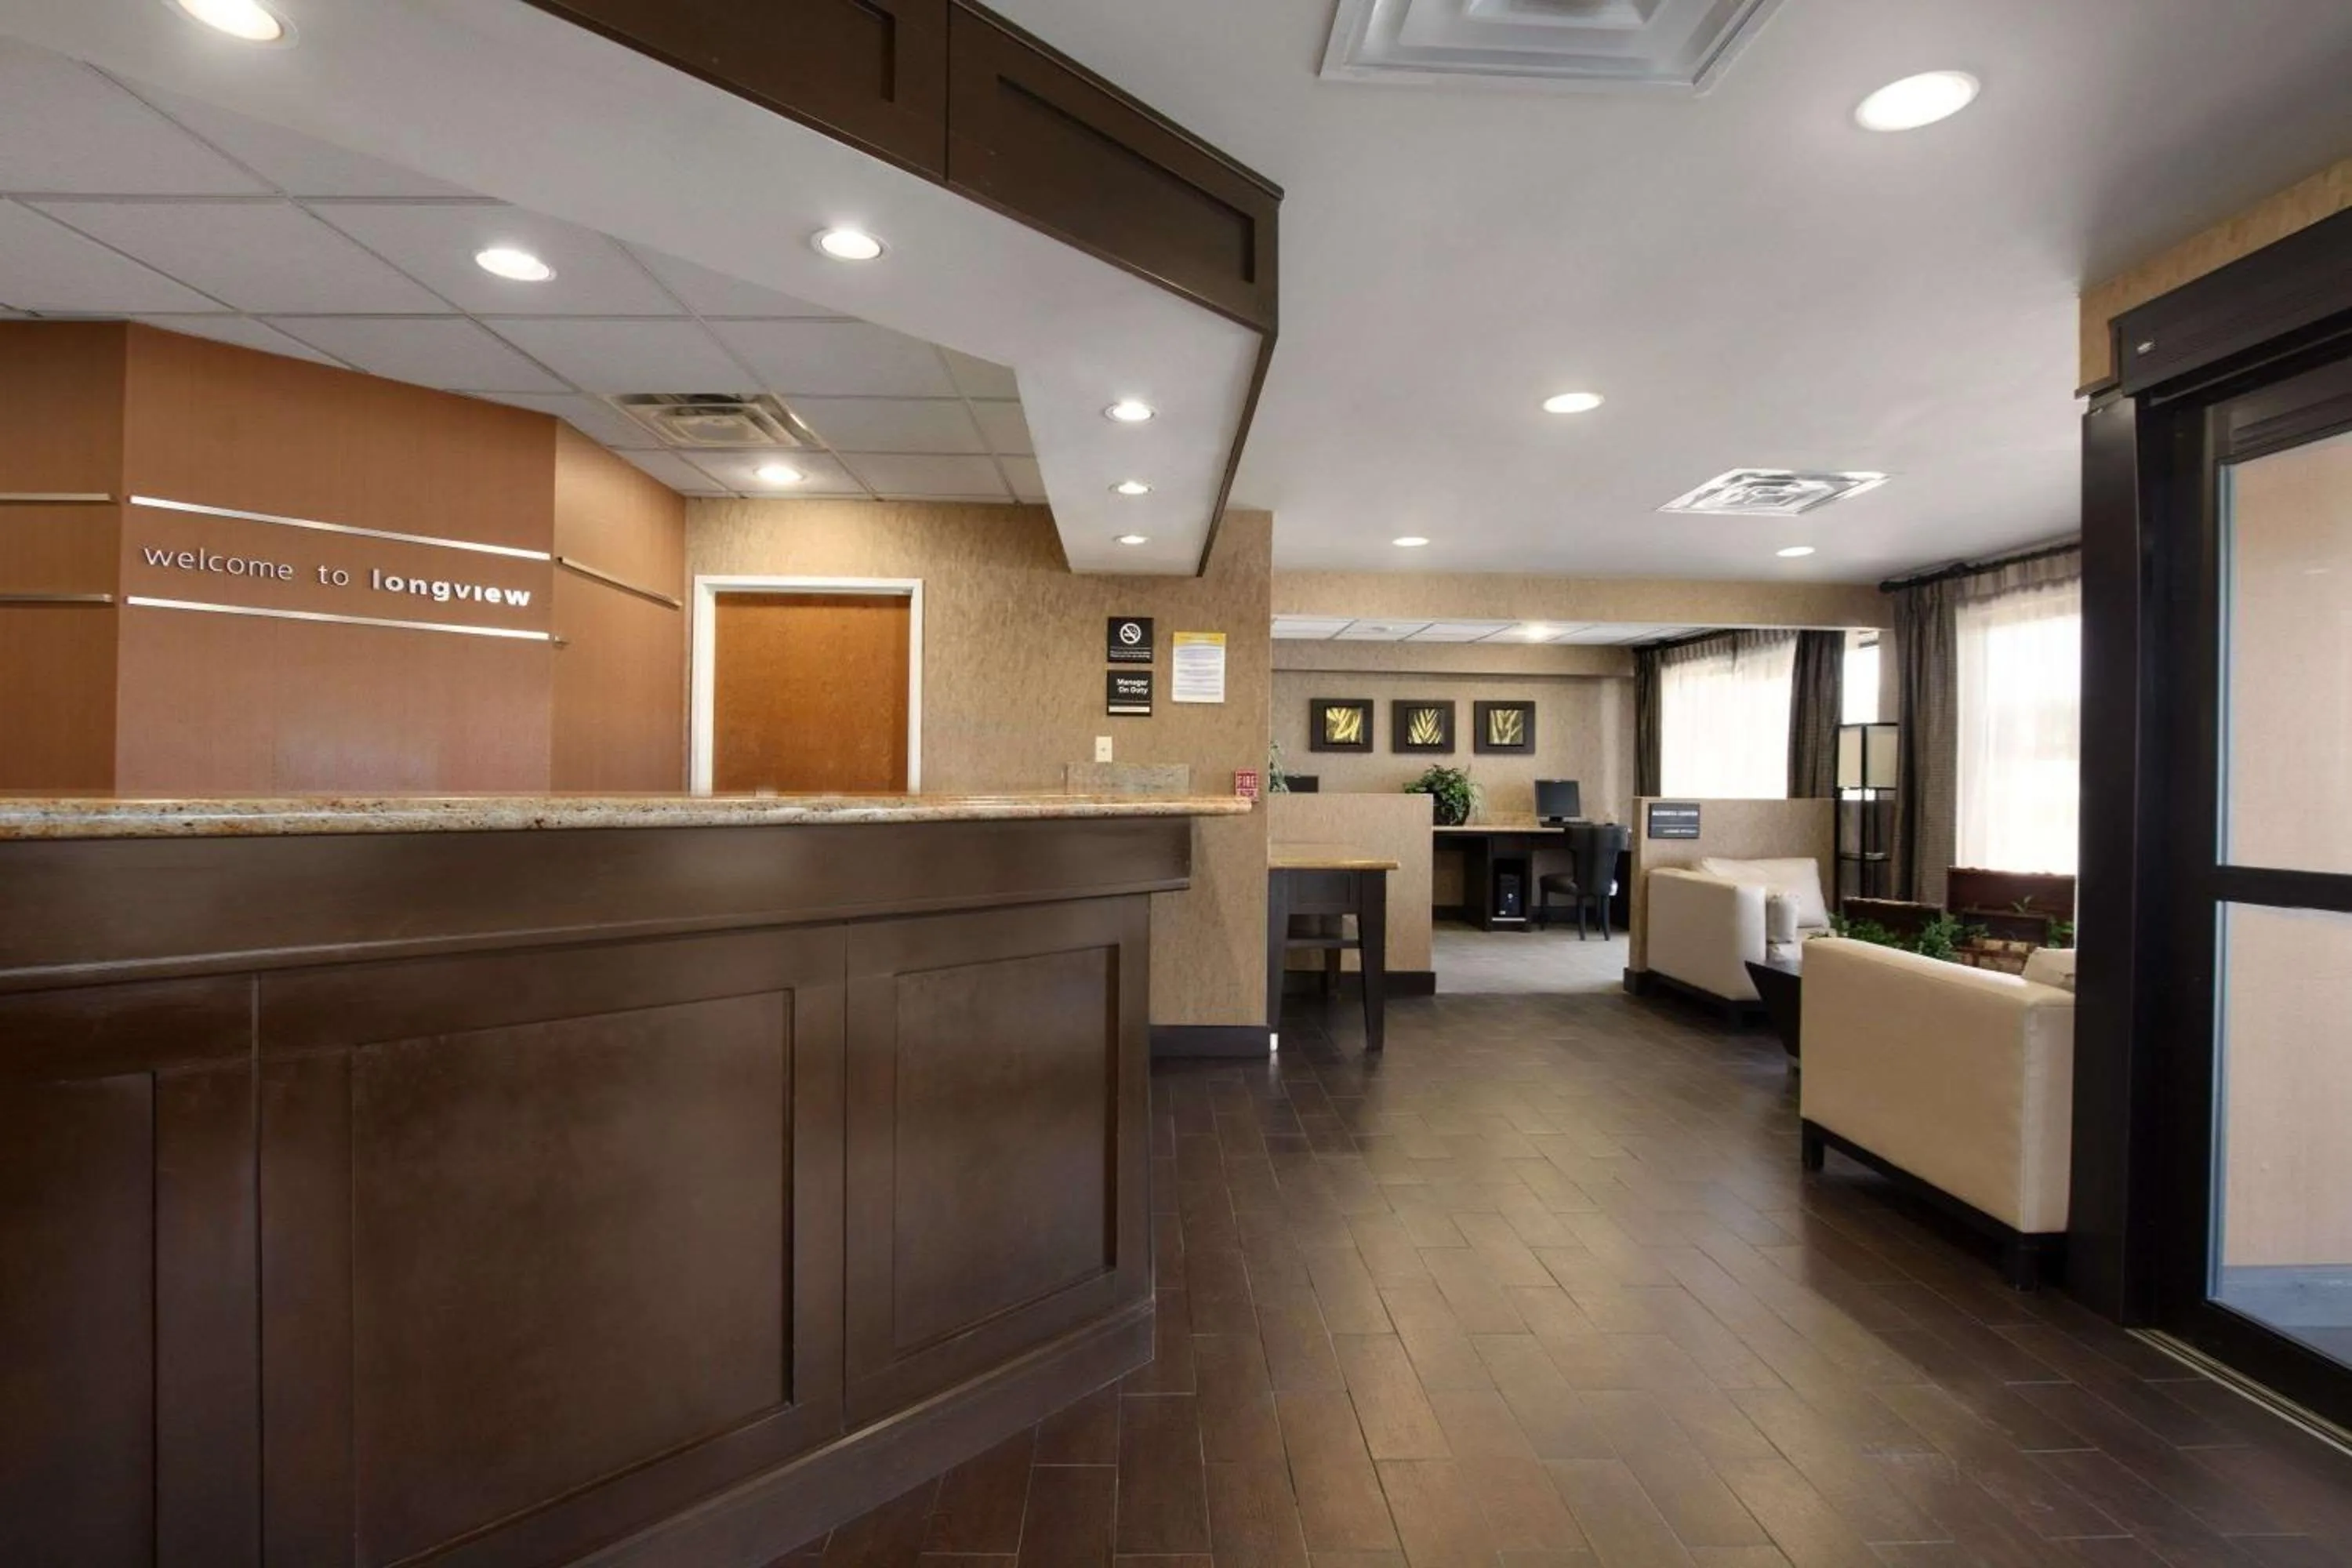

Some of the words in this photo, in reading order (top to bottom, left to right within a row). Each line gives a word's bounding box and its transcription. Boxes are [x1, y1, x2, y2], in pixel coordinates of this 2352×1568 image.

[143, 547, 293, 581] welcome
[318, 564, 350, 586] to
[372, 568, 532, 607] longview
[1116, 678, 1149, 687] Manager
[1130, 686, 1149, 695] Duty
[1236, 775, 1258, 788] FIRE
